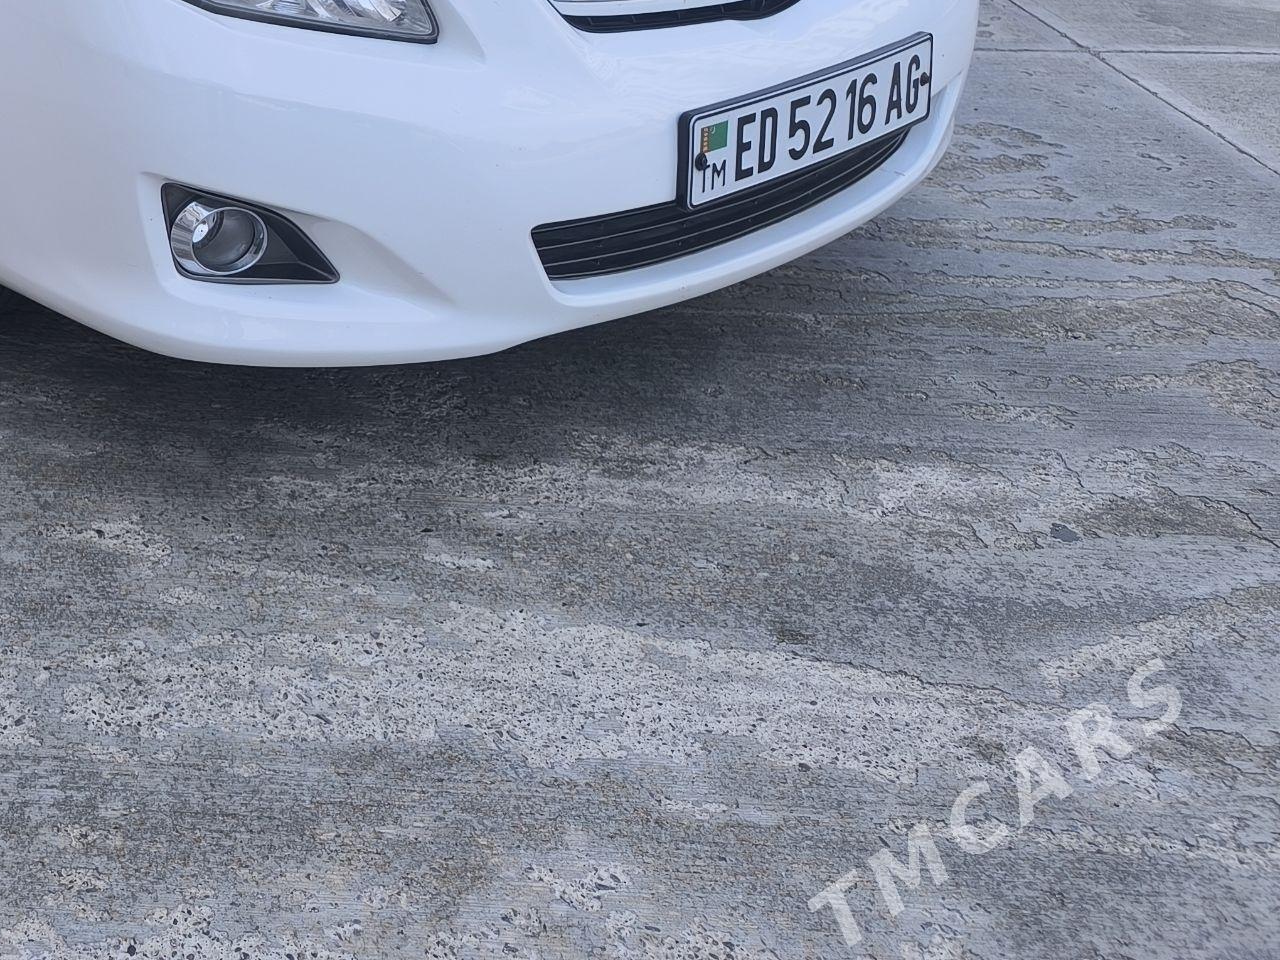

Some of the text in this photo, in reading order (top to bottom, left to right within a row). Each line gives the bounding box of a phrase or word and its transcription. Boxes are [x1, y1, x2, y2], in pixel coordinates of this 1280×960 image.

[734, 106, 779, 182] ED
[884, 54, 921, 126] AG
[699, 158, 727, 193] TM
